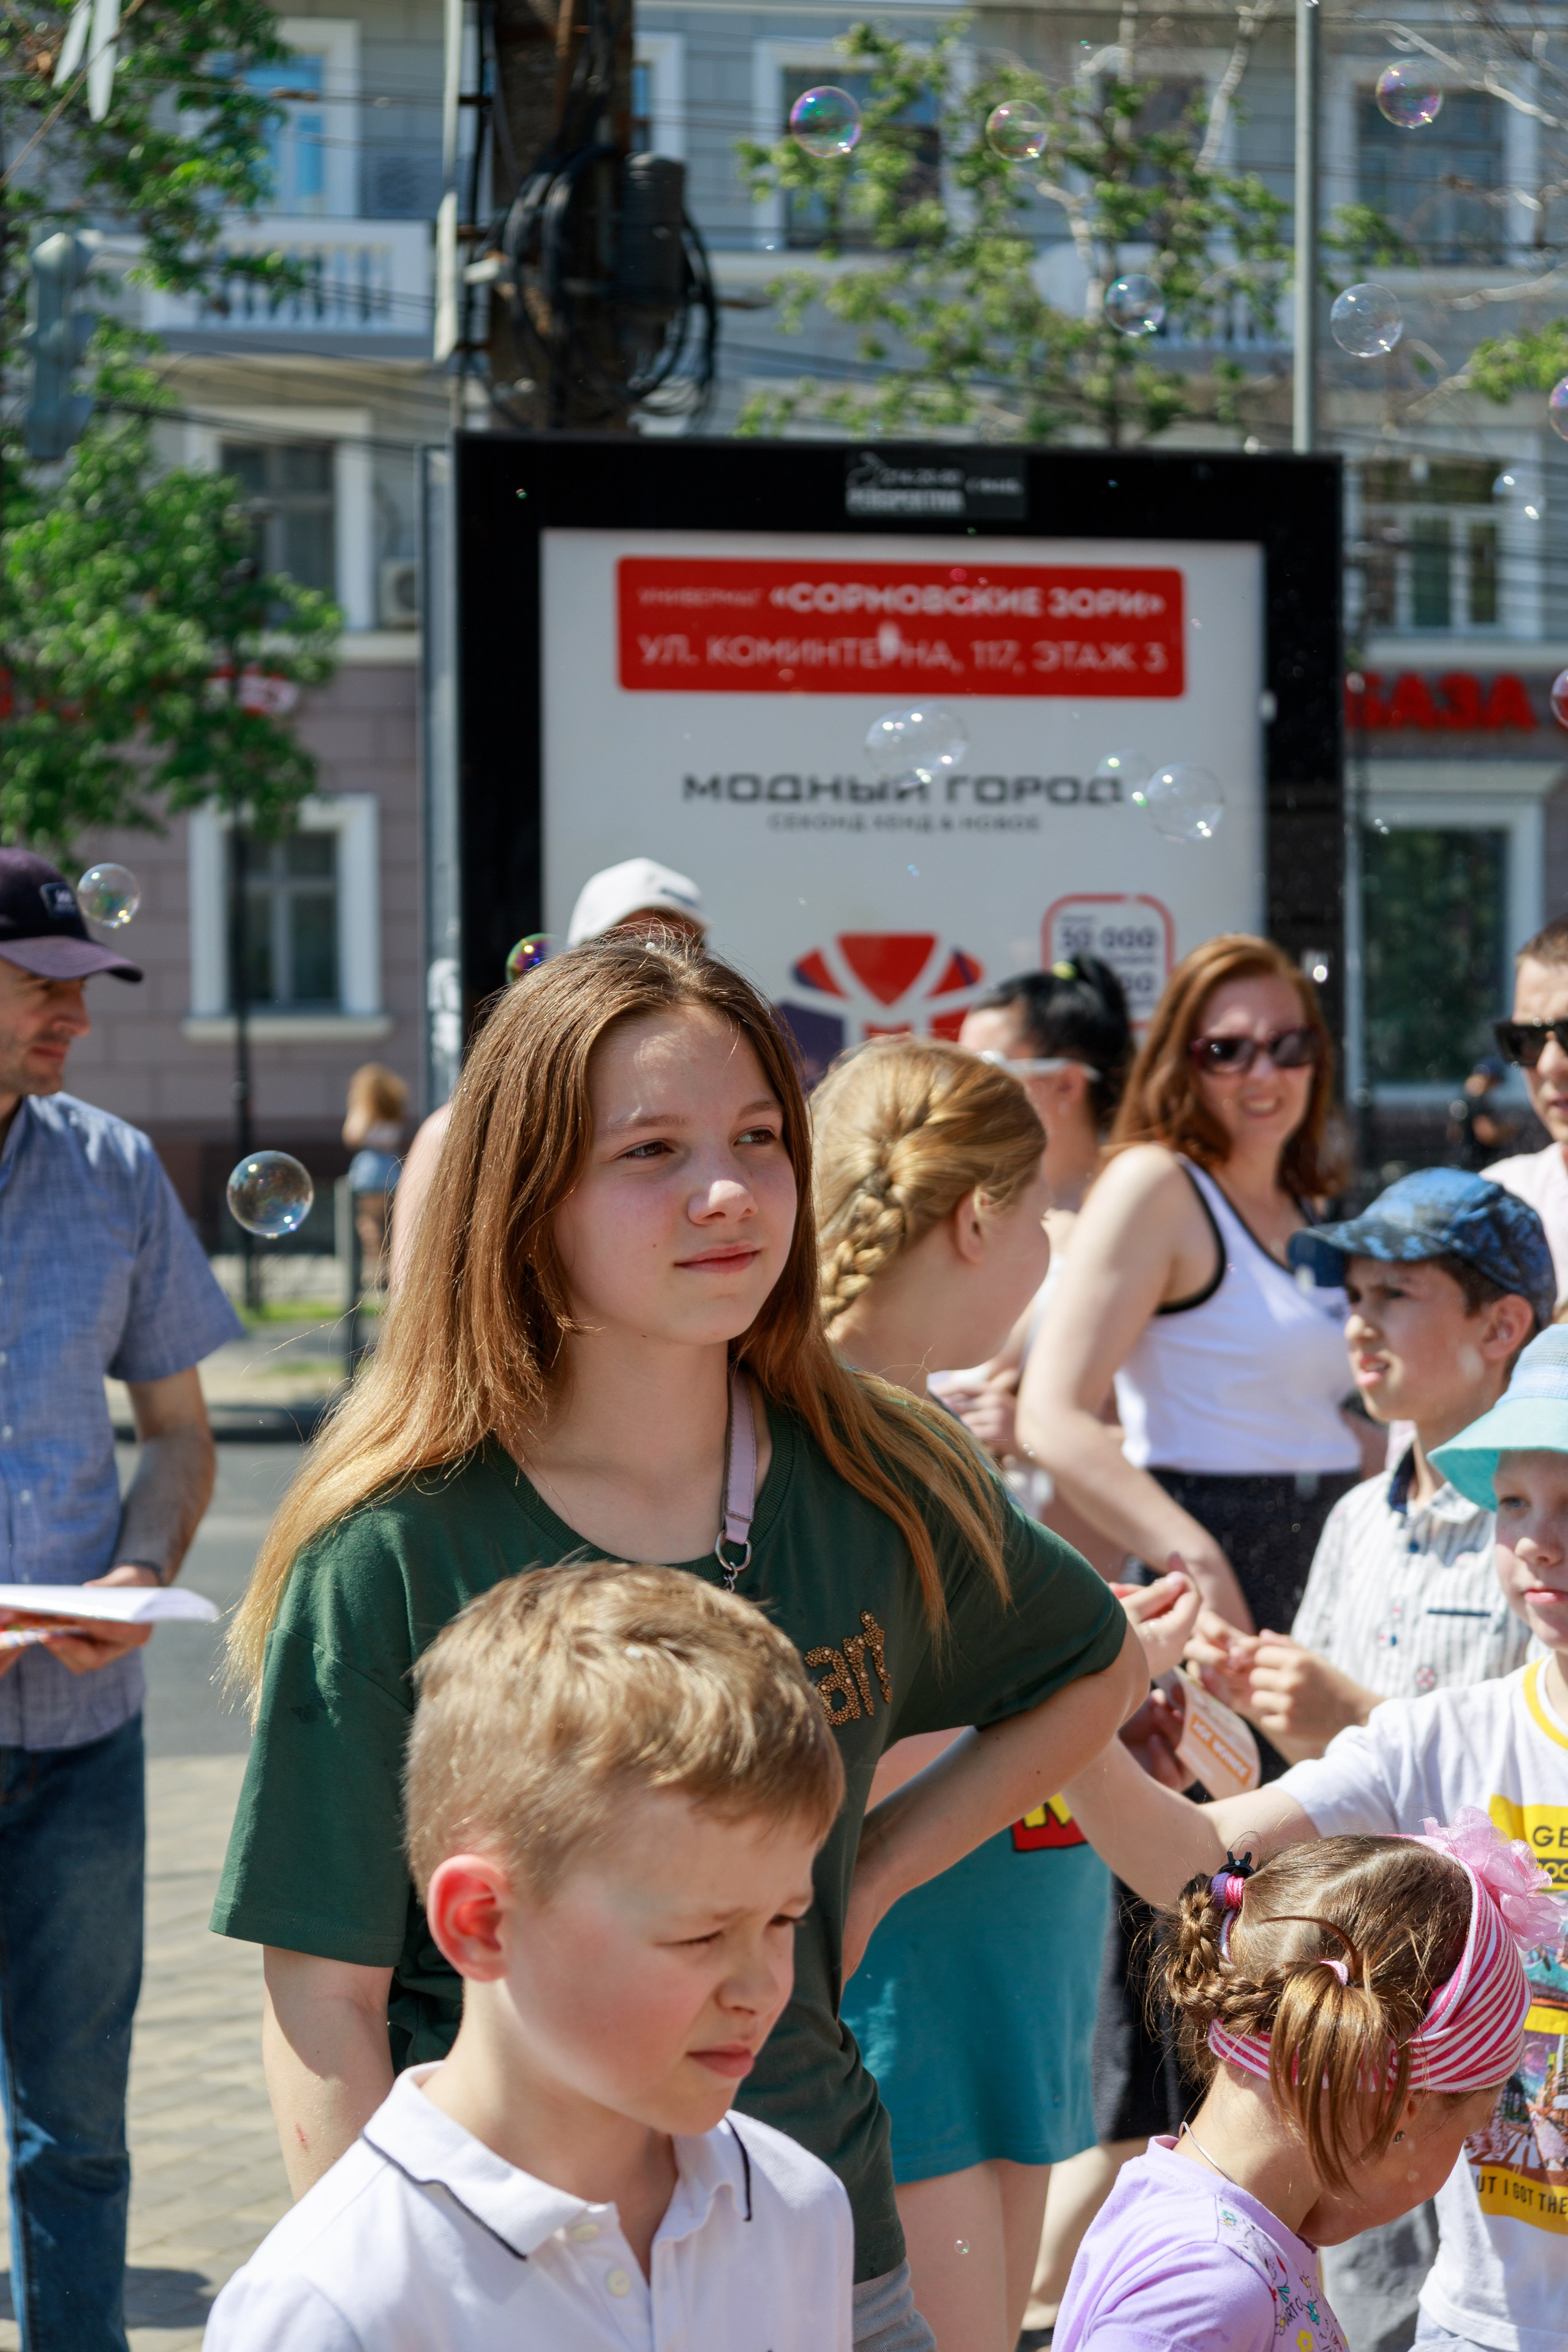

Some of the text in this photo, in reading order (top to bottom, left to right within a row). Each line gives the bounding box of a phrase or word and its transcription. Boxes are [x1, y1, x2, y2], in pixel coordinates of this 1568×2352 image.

[769, 582, 1042, 618] «СОРМОВСКИЕ
[1048, 586, 1166, 618] ЗОРИ»
[638, 634, 699, 667] УЛ.
[1032, 639, 1136, 672] ЭТАЖ
[1144, 641, 1168, 673] 3
[946, 774, 1122, 805] ГОРОД
[1504, 2179, 1509, 2195] I
[1513, 2182, 1534, 2206] GOT
